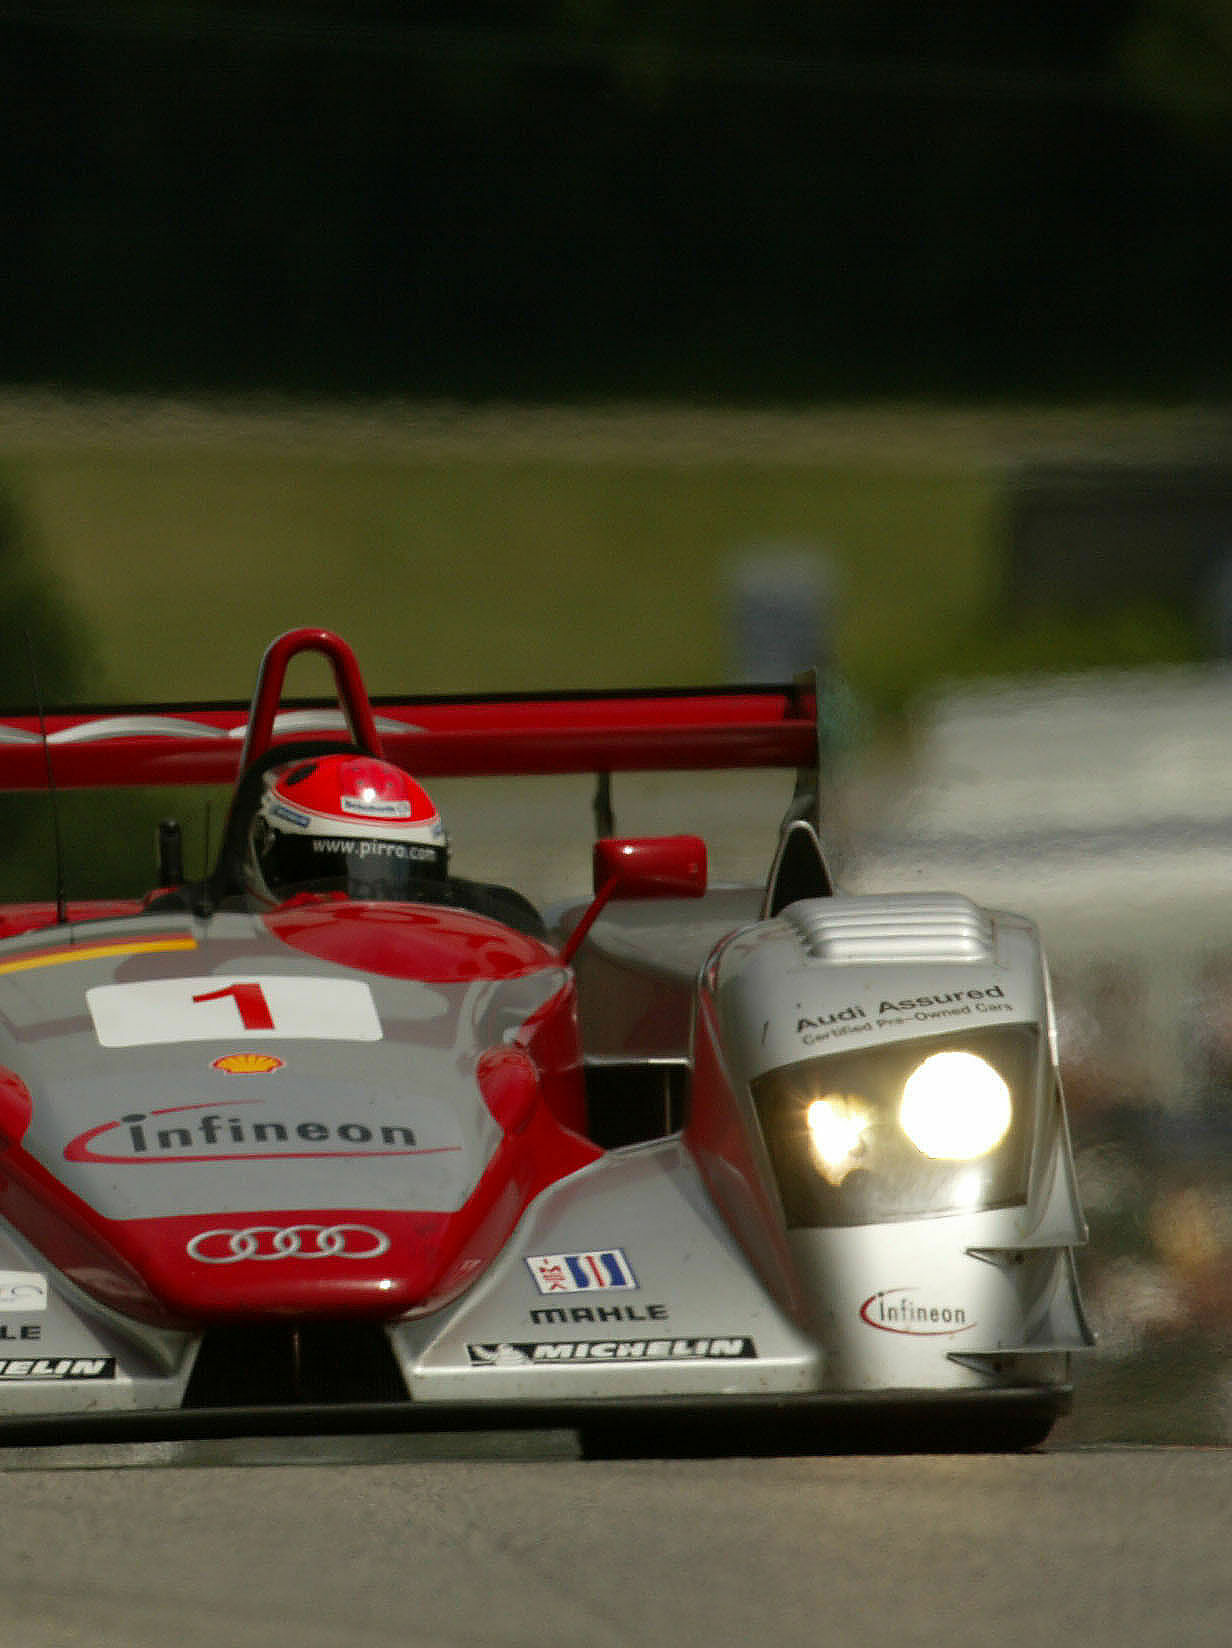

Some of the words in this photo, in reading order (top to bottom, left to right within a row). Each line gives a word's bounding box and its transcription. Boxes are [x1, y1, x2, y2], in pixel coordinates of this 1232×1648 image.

[193, 982, 276, 1030] 1
[796, 1006, 866, 1033] Audi
[878, 984, 1005, 1016] Assured
[529, 1304, 669, 1325] MAHLE
[534, 1339, 745, 1359] MICHELIN
